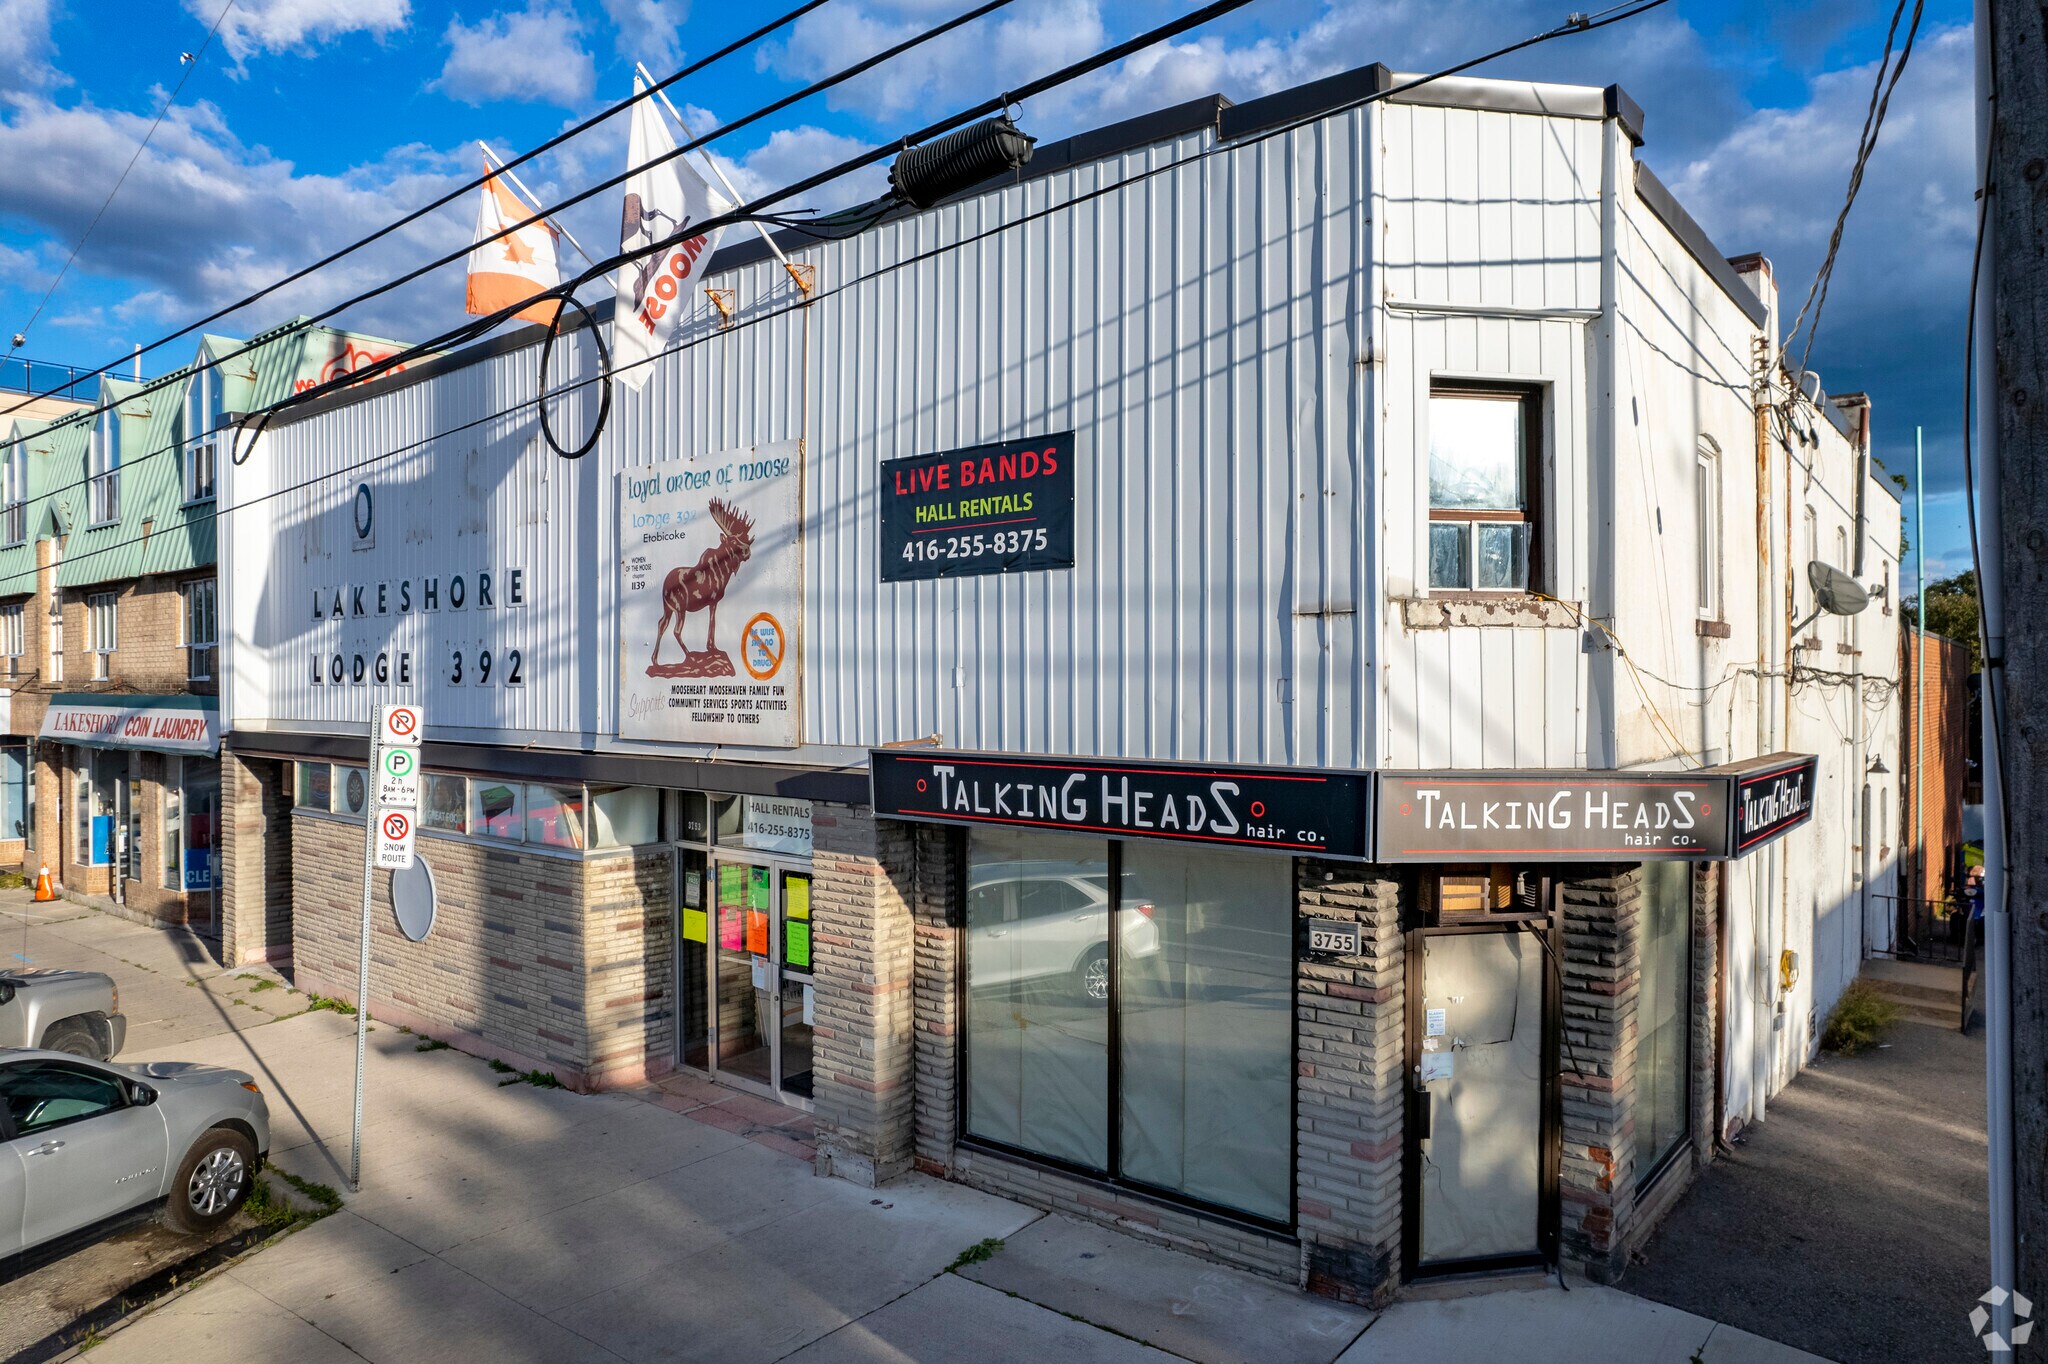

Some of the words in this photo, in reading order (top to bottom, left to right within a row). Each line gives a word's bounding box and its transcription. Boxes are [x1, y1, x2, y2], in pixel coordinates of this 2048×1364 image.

[895, 464, 950, 495] LIVE
[960, 447, 1058, 487] BANDS
[915, 502, 956, 523] HALL
[959, 492, 1033, 519] RENTALS
[676, 510, 697, 525] 392
[643, 530, 686, 543] Etobicoke
[902, 527, 1047, 562] 416-255-8375
[639, 563, 652, 571] MOOSE
[314, 569, 522, 618] LAKESHORE
[760, 628, 775, 636] WISE
[314, 652, 410, 683] LODGE
[451, 650, 522, 684] 392
[671, 685, 706, 695] MOOSEHEART
[709, 685, 747, 696] MOOSEHAVEN
[749, 686, 770, 696] FAMILY
[773, 686, 785, 696] FUN
[668, 698, 701, 708] COMMUNITY
[703, 699, 728, 709] SERVICES
[731, 699, 753, 709] SPORTS
[755, 700, 787, 711] ACTIVITIES
[691, 712, 724, 723] FELLOWSHIP
[727, 713, 735, 723] TO
[738, 713, 760, 724] OTHERS
[54, 713, 122, 735] LAKESHORE
[125, 716, 152, 737] COIN
[152, 717, 209, 741] LAUNDRY
[933, 765, 1087, 821] TALKING
[1101, 774, 1240, 835] HEADS
[749, 802, 770, 815] HALL
[772, 804, 810, 818] RENTALS
[1416, 789, 1572, 830] TALKING
[1583, 790, 1695, 830] HEADS
[747, 824, 810, 840] 416-255-8375
[1246, 822, 1286, 840] hair
[1297, 829, 1325, 842] co.
[1624, 832, 1661, 846] hair
[1672, 836, 1697, 846] co.
[384, 843, 406, 852] SNOW
[382, 854, 406, 863] ROUTE
[1314, 932, 1353, 950] 3755
